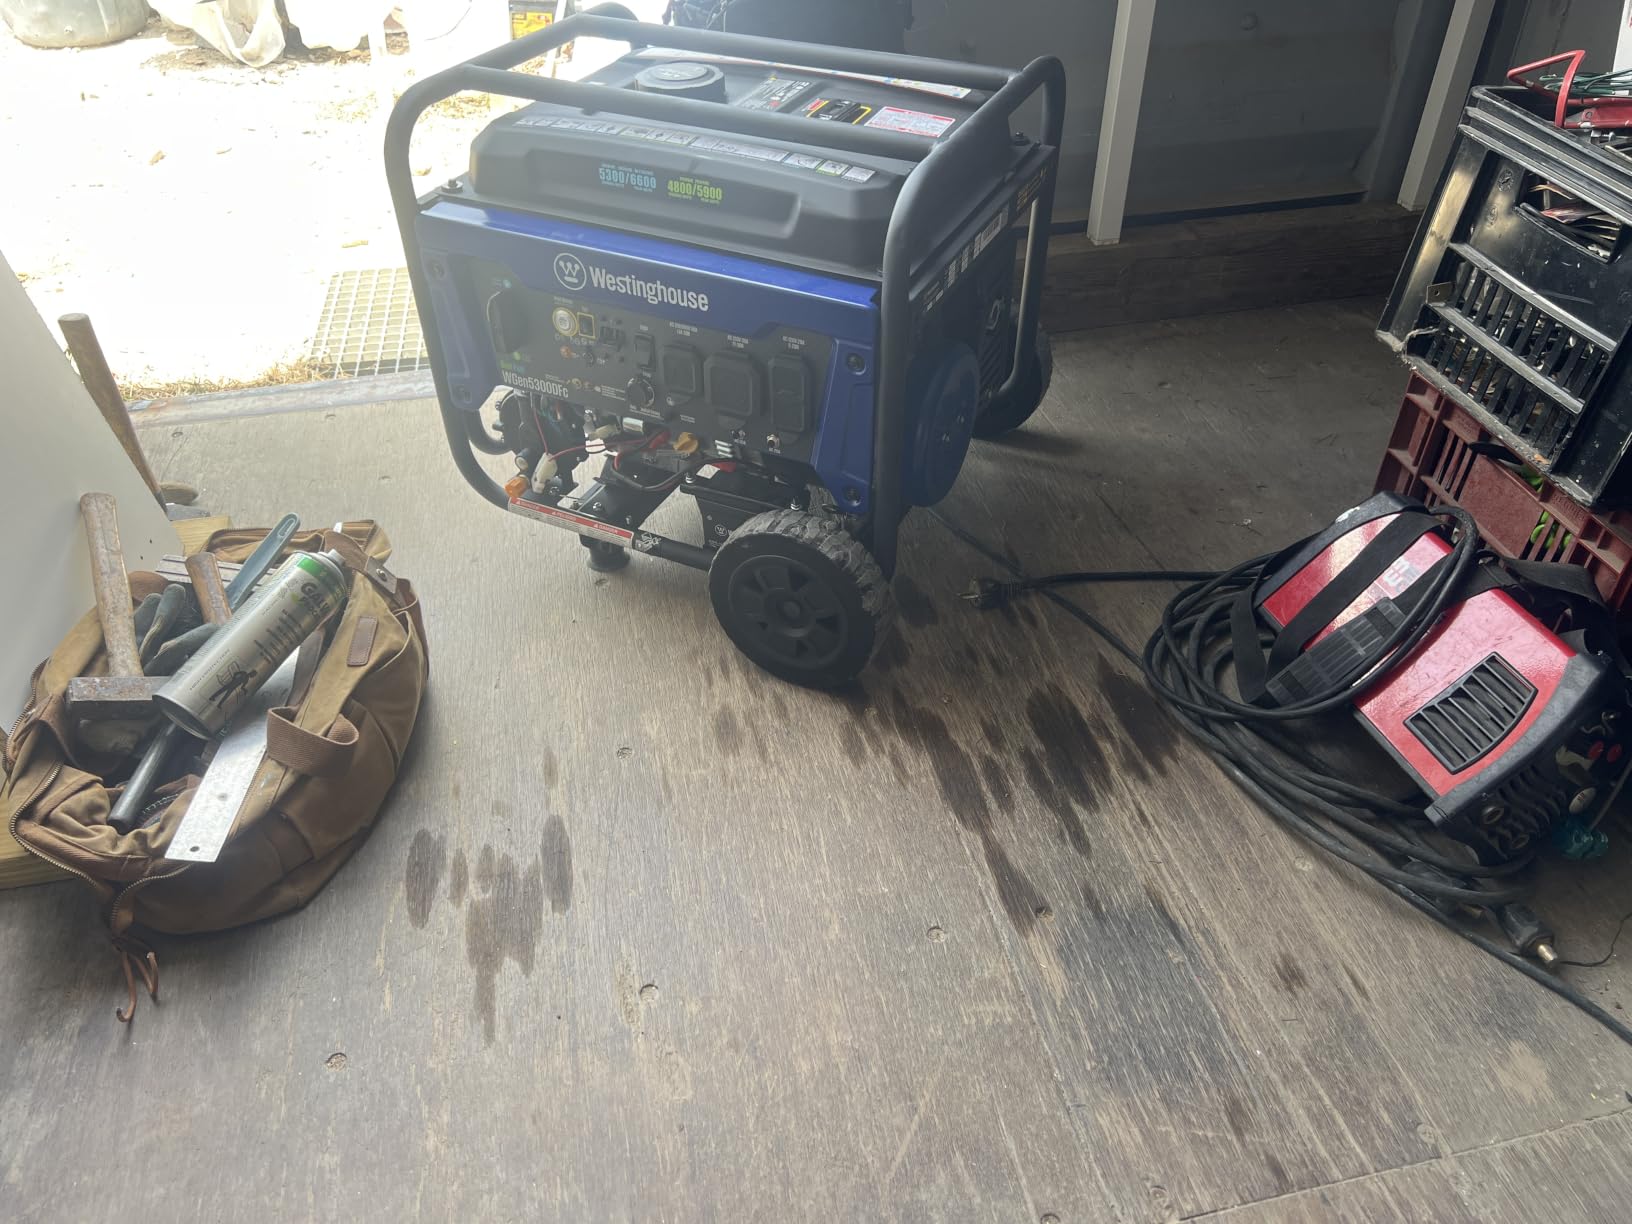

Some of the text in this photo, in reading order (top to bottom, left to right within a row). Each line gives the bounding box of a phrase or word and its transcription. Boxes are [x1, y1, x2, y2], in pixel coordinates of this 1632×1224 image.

[599, 167, 657, 190] 5300/6600
[667, 180, 723, 201] 4800/5900
[589, 265, 709, 312] Westinghouse
[501, 370, 569, 398] WGen5300DFc
